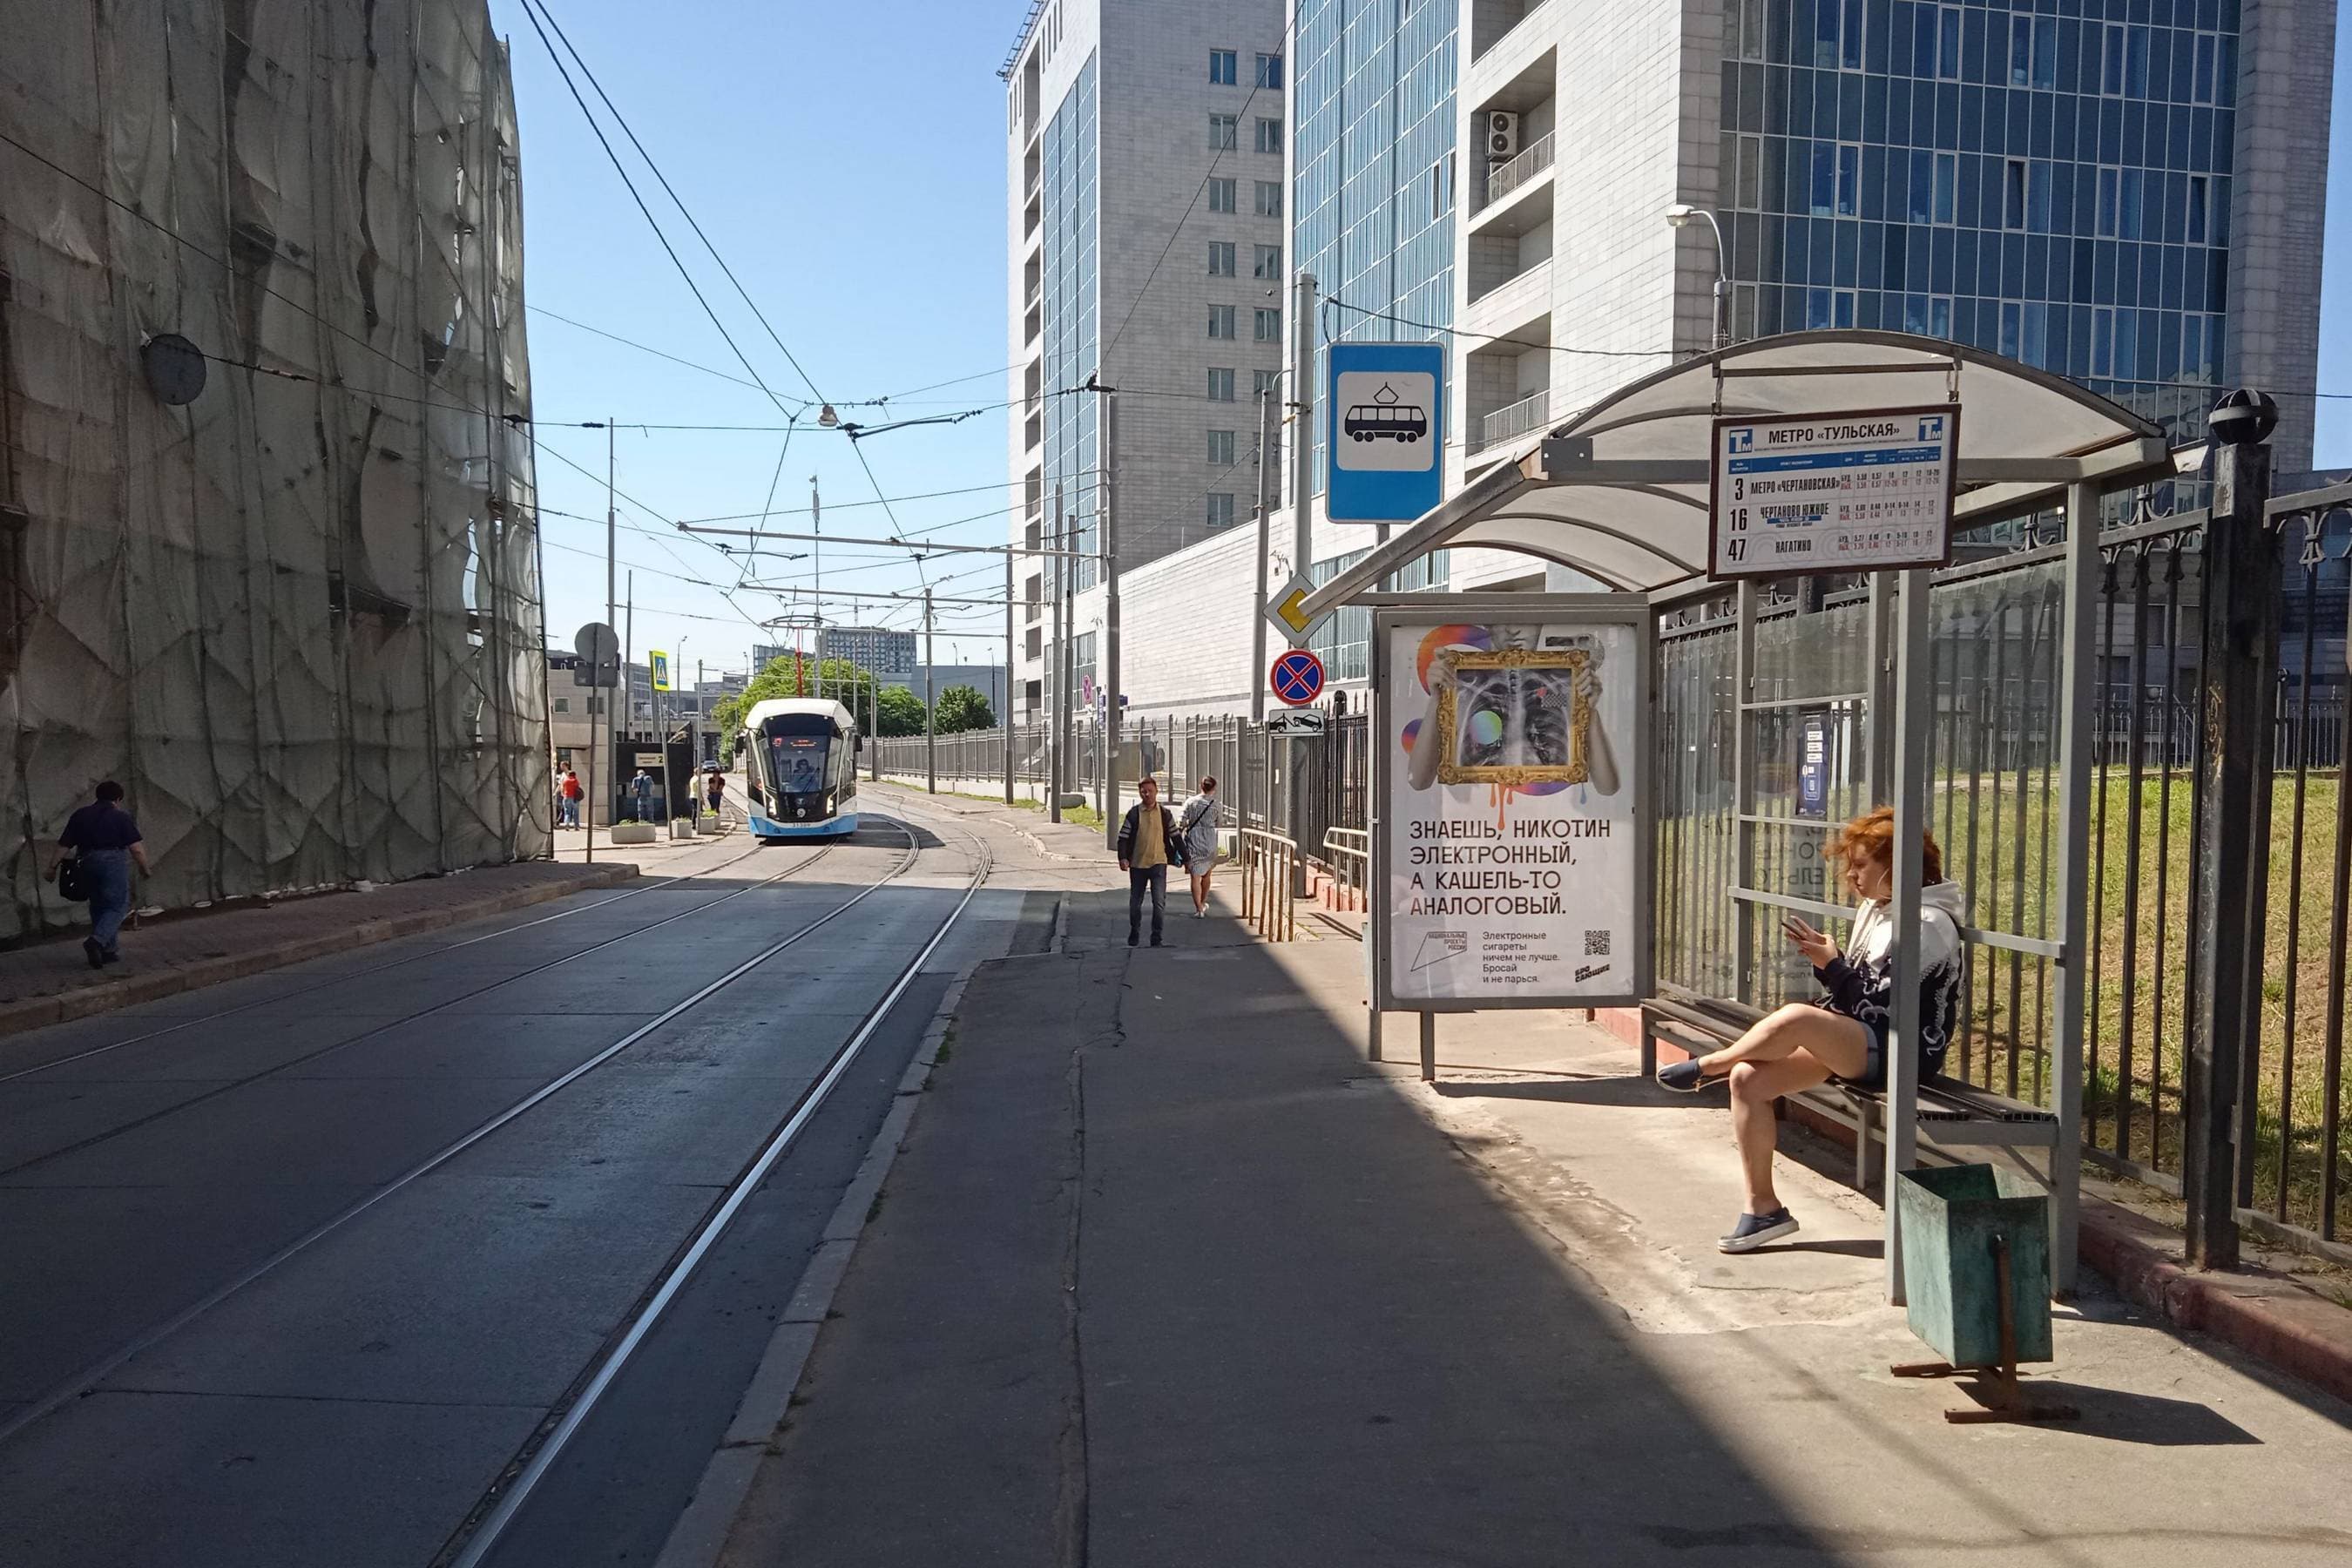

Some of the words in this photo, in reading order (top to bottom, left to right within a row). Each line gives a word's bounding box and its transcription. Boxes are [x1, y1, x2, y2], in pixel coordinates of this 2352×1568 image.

[1769, 429, 1814, 444] МЕТРО
[1817, 422, 1900, 441] «ТУЛЬСКАЯ»
[1735, 478, 1743, 500] 3
[1751, 481, 1776, 495] МЕТРО
[1777, 476, 1841, 492] «ЧЕРТАНОВСКАЯ»
[1730, 509, 1747, 531] 16
[1761, 505, 1801, 518] ЧЕРТАНОВО
[1802, 503, 1829, 517] ЮЖНОЕ
[1728, 538, 1747, 561] 47
[1776, 539, 1811, 553] НАГАТИНО
[1409, 820, 1502, 841] ЗНАЕШЬ,
[1513, 819, 1610, 838] НИКОТИН
[1409, 841, 1577, 865] ЭЛЕКТРОННЫЙ,
[1410, 872, 1424, 889] А
[1436, 870, 1561, 889] КАШЕЛЬ-ТО
[1410, 891, 1566, 916] АНАЛОГОВЫЙ.
[1483, 931, 1547, 942] Электронные
[1483, 943, 1527, 953] сигареты
[1528, 954, 1560, 963] лучше.
[1483, 963, 1517, 974] Бросай
[1504, 976, 1539, 984] парься.
